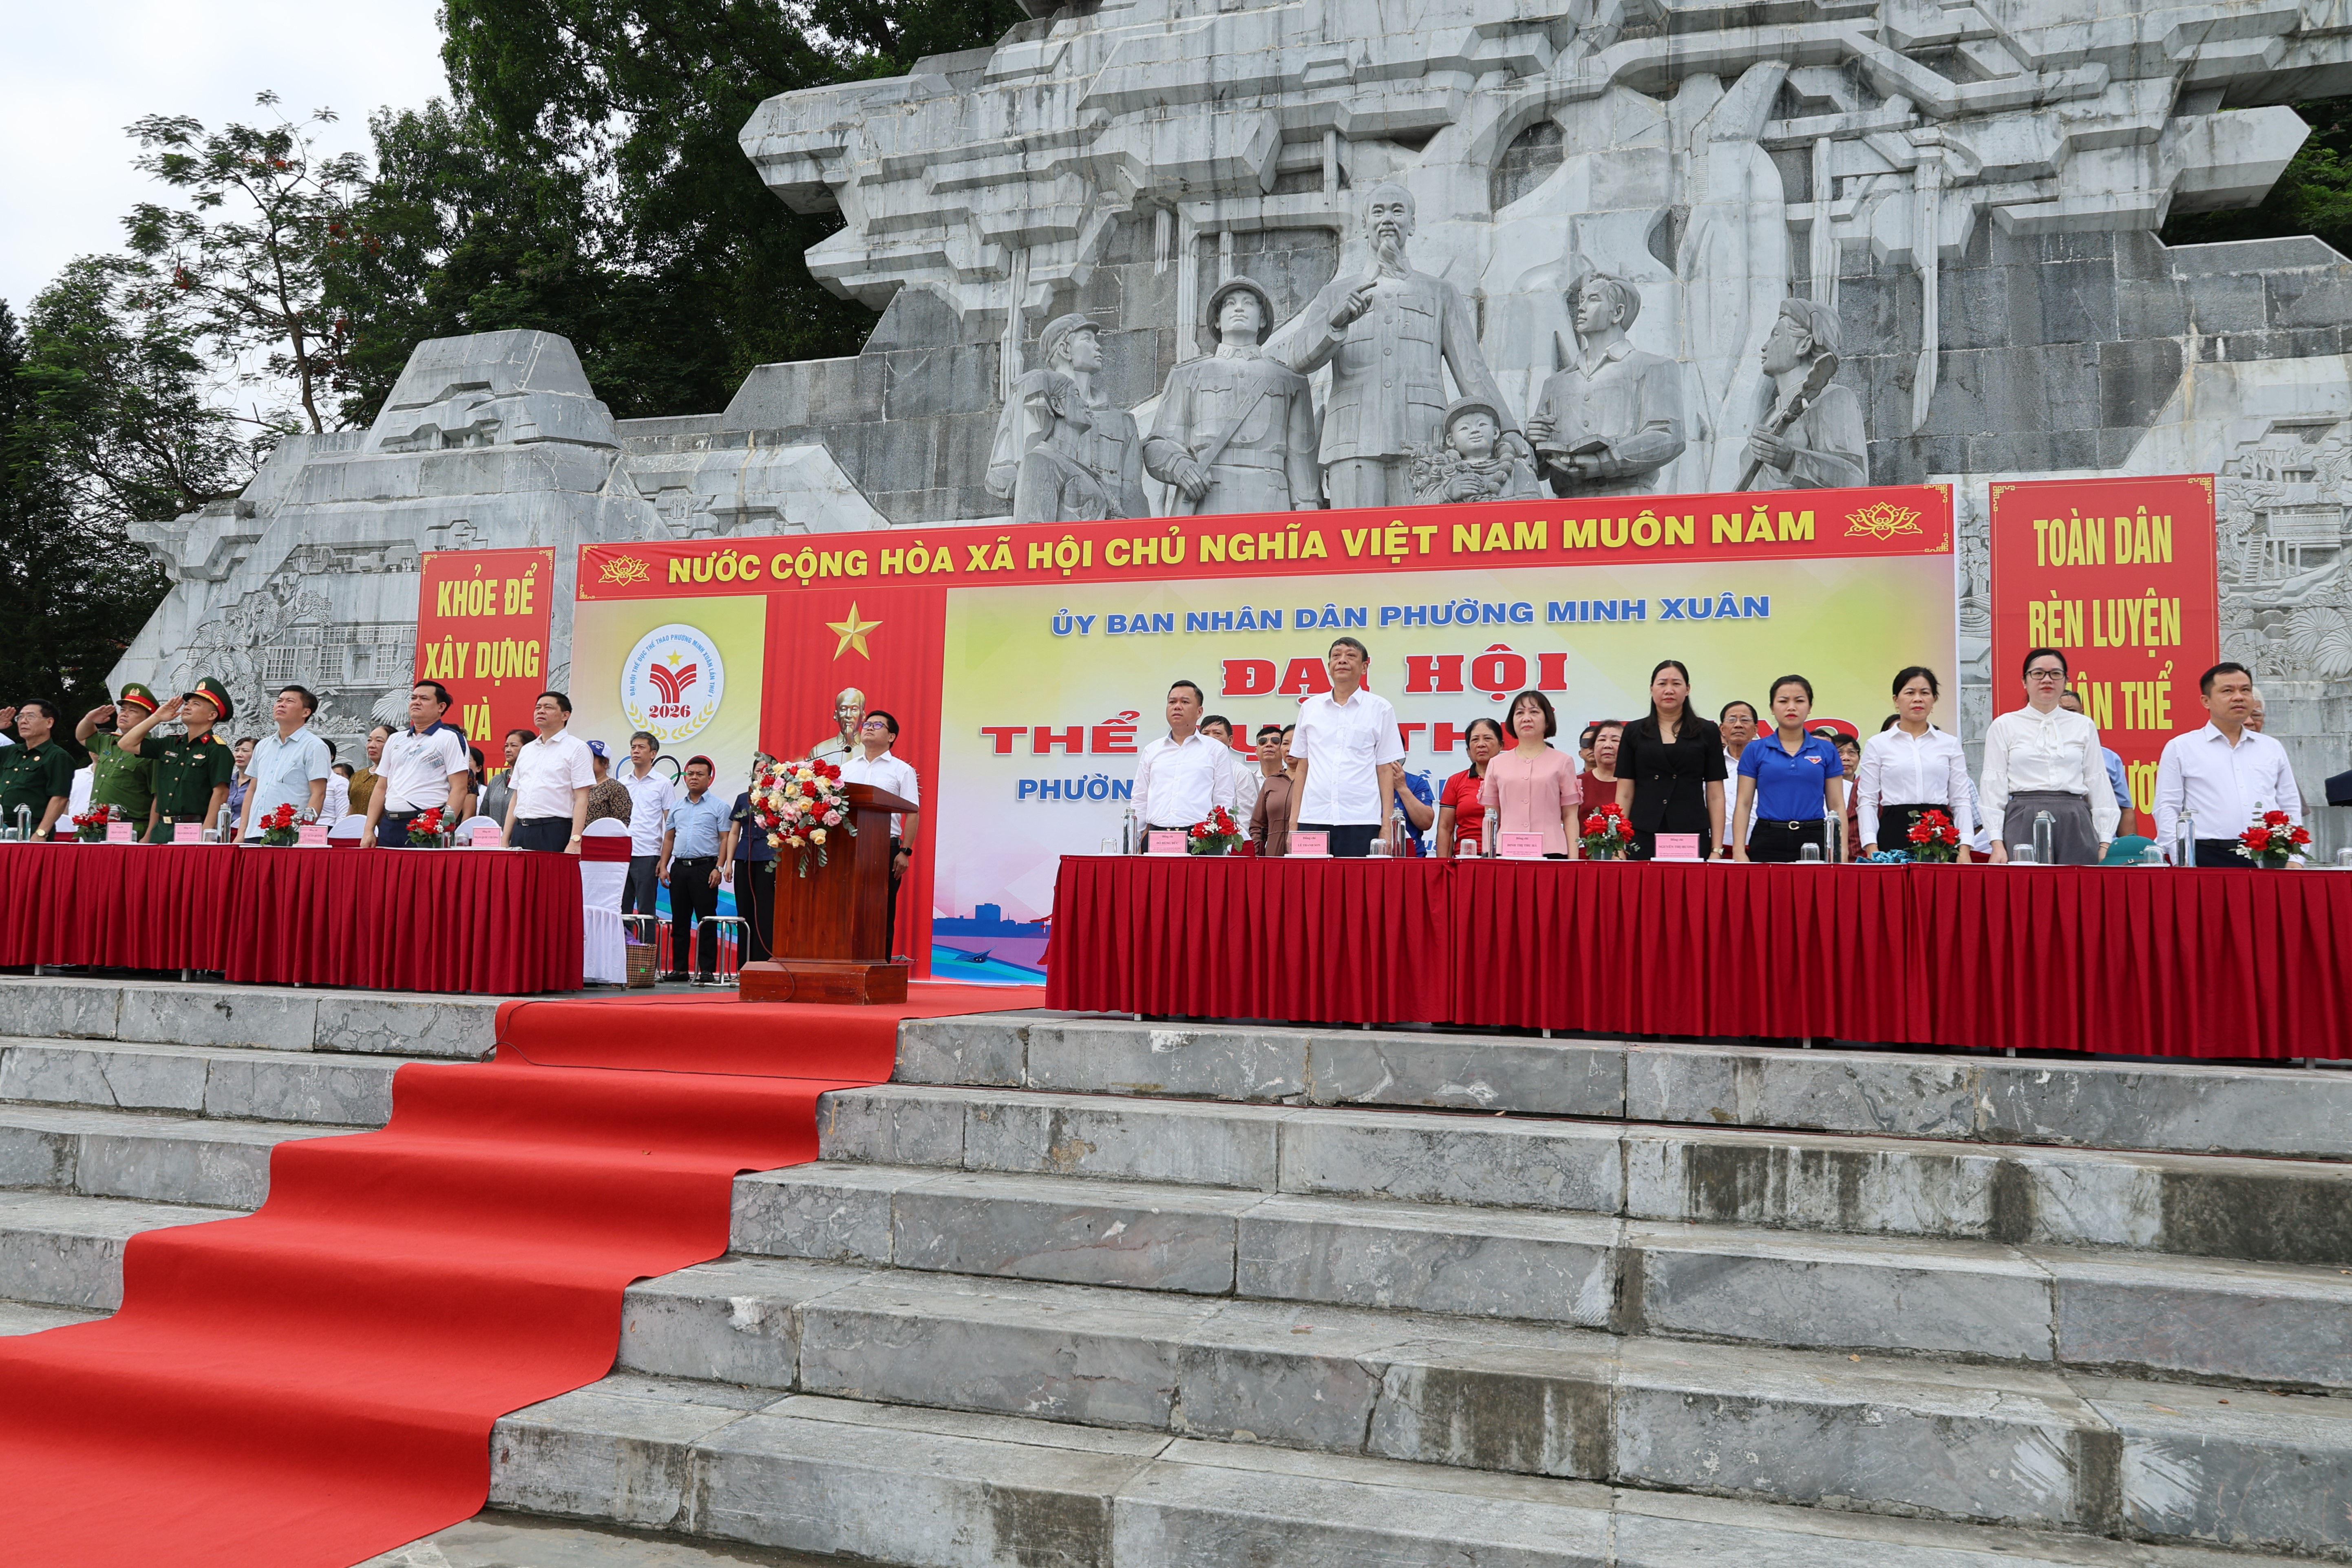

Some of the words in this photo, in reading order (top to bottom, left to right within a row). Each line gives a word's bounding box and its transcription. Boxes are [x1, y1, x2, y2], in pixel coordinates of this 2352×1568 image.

[669, 549, 760, 583] NƯỚC
[771, 547, 867, 585] CỘNG
[881, 540, 954, 574] HÒA
[966, 536, 1014, 571] XÃ
[1028, 535, 1092, 576] HỘI
[1105, 526, 1185, 566] CHỦ
[1200, 523, 1327, 562] NGHĨA
[1341, 520, 1438, 563] VIỆT
[1453, 521, 1547, 552] NAM
[1564, 510, 1694, 548] MUÔN
[1712, 505, 1814, 543] NĂM
[2033, 508, 2105, 566] TOÀN
[2114, 505, 2172, 564] DÂN
[437, 564, 497, 617] KHỎE
[504, 562, 537, 615] ĐỂ
[1052, 609, 1096, 635] ỦY
[1108, 613, 1174, 633] BAN
[1186, 606, 1283, 631] NHÂN
[1296, 603, 1367, 628] DÂN
[1380, 598, 1533, 626] PHƯỜNG
[1548, 599, 1646, 622] MINH
[1659, 592, 1769, 619] XUÂN
[656, 635, 669, 644] THAO
[692, 640, 705, 653] MINH
[2029, 590, 2083, 648] RÈN
[2093, 587, 2181, 657] LUYỆN
[423, 635, 470, 679] XÂY
[475, 637, 540, 686] DỰNG
[1406, 644, 1567, 701] HỘI
[463, 696, 491, 741] VÀ
[649, 705, 691, 718] 2026
[2121, 660, 2173, 729] THỂ
[981, 710, 1140, 754] THỂ
[1018, 773, 1133, 800] PHƯỜN
